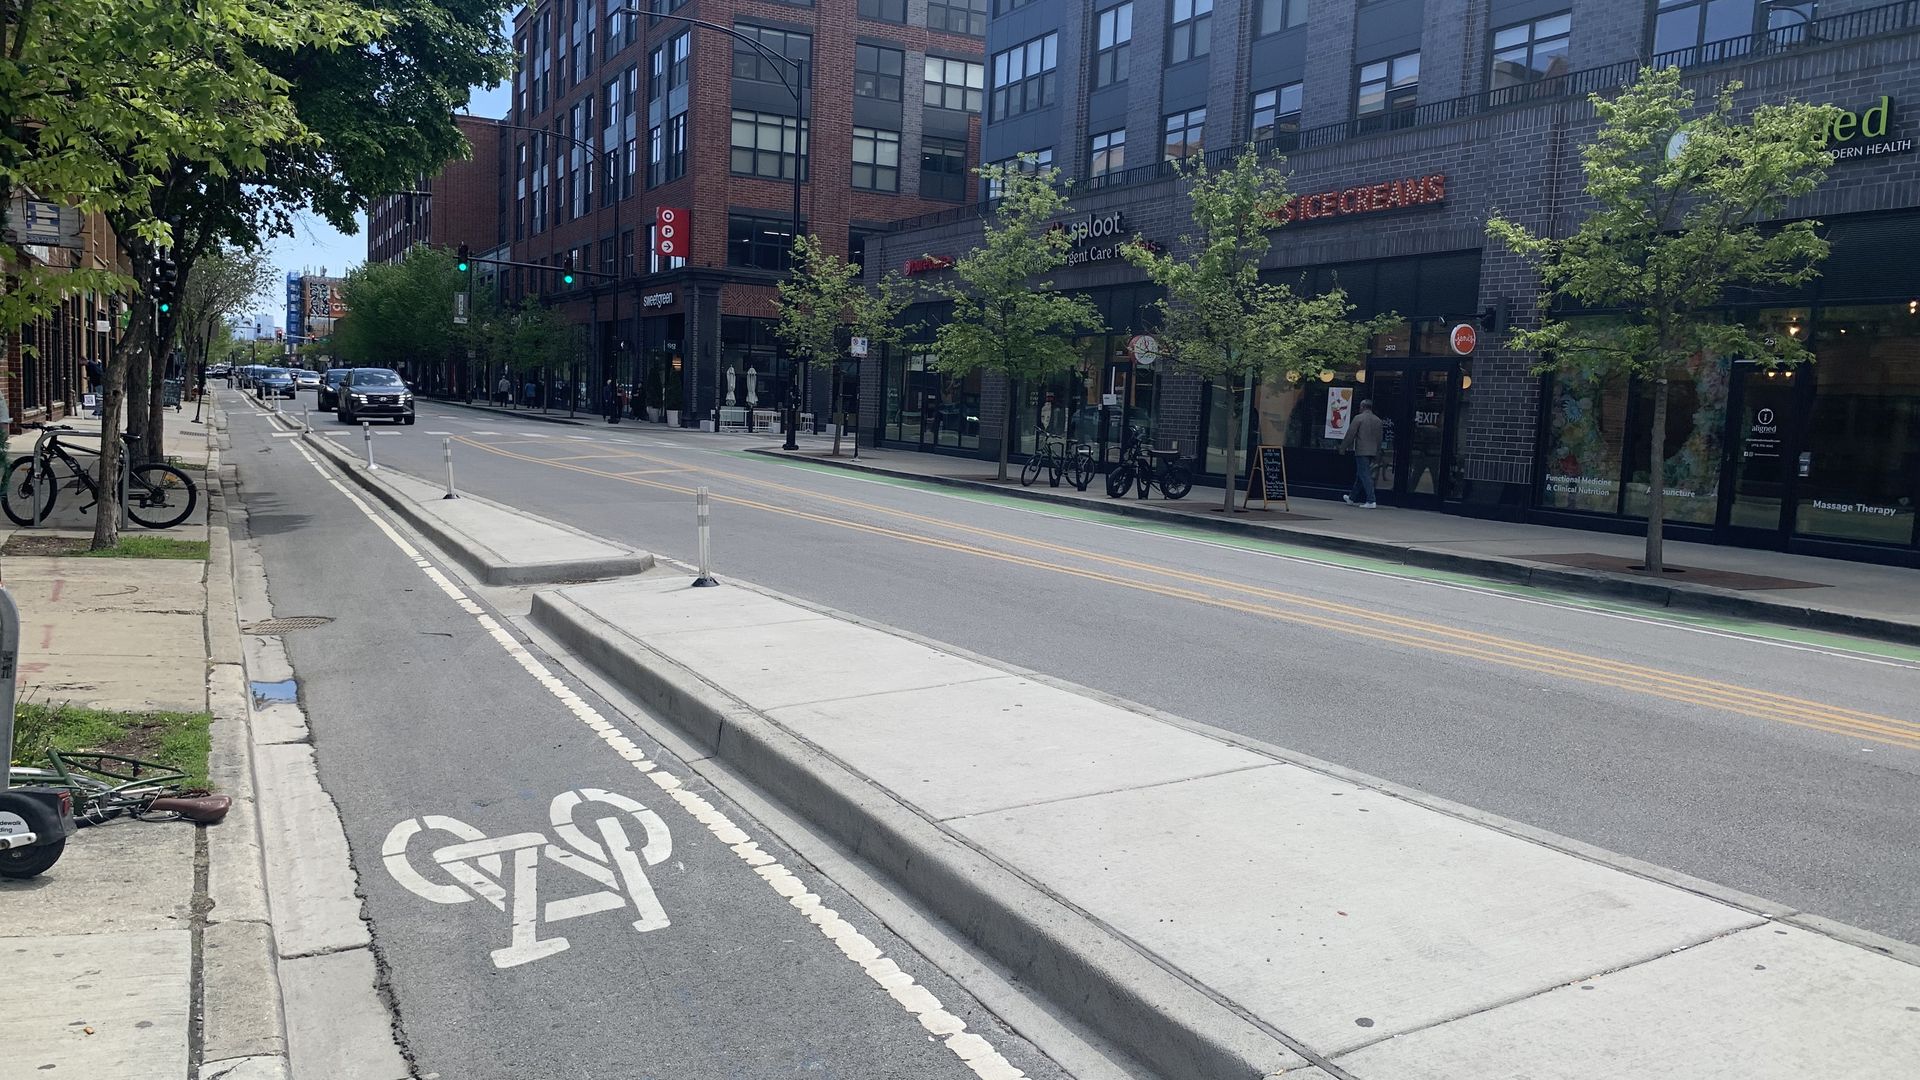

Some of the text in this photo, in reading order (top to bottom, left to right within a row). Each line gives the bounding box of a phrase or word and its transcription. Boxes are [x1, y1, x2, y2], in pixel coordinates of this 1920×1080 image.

[1825, 139, 1911, 160] DERN HEALTH
[1300, 191, 1338, 220] ICE
[1340, 174, 1445, 213] CREAMS
[1071, 211, 1120, 247] sploot
[1065, 251, 1089, 267] rgent
[1090, 246, 1112, 261] Care
[643, 291, 673, 308] sweetgreen
[1418, 412, 1440, 424] EXIT
[1751, 424, 1777, 434] aligned
[1546, 473, 1612, 486] Functional Medicine
[1553, 485, 1577, 493] Clinical
[1578, 487, 1610, 496] Nutrition
[1646, 486, 1696, 498] Apuncture
[1813, 500, 1896, 516] Massage Therapy
